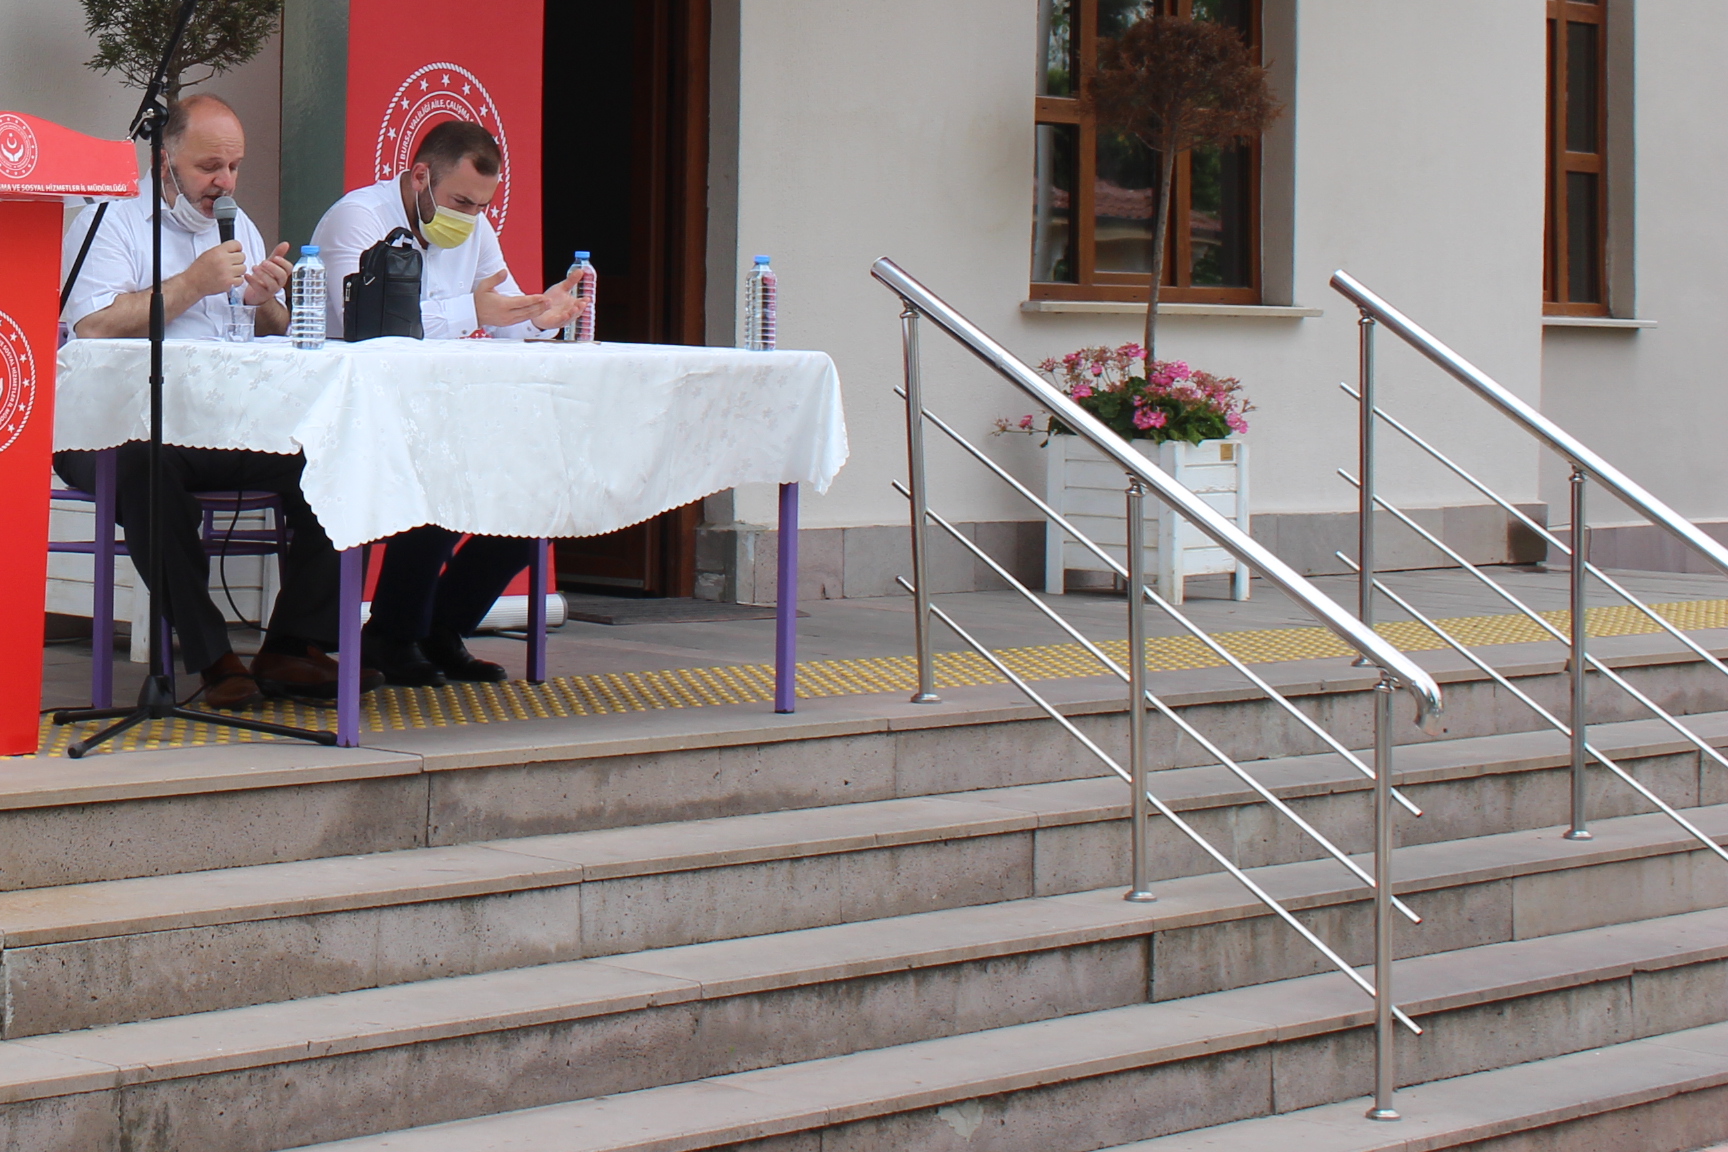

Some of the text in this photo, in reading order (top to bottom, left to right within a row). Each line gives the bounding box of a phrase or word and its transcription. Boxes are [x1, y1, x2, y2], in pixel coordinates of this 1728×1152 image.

[400, 130, 412, 160] BURSA
[11, 183, 20, 191] VE
[21, 183, 44, 191] SOSYAL
